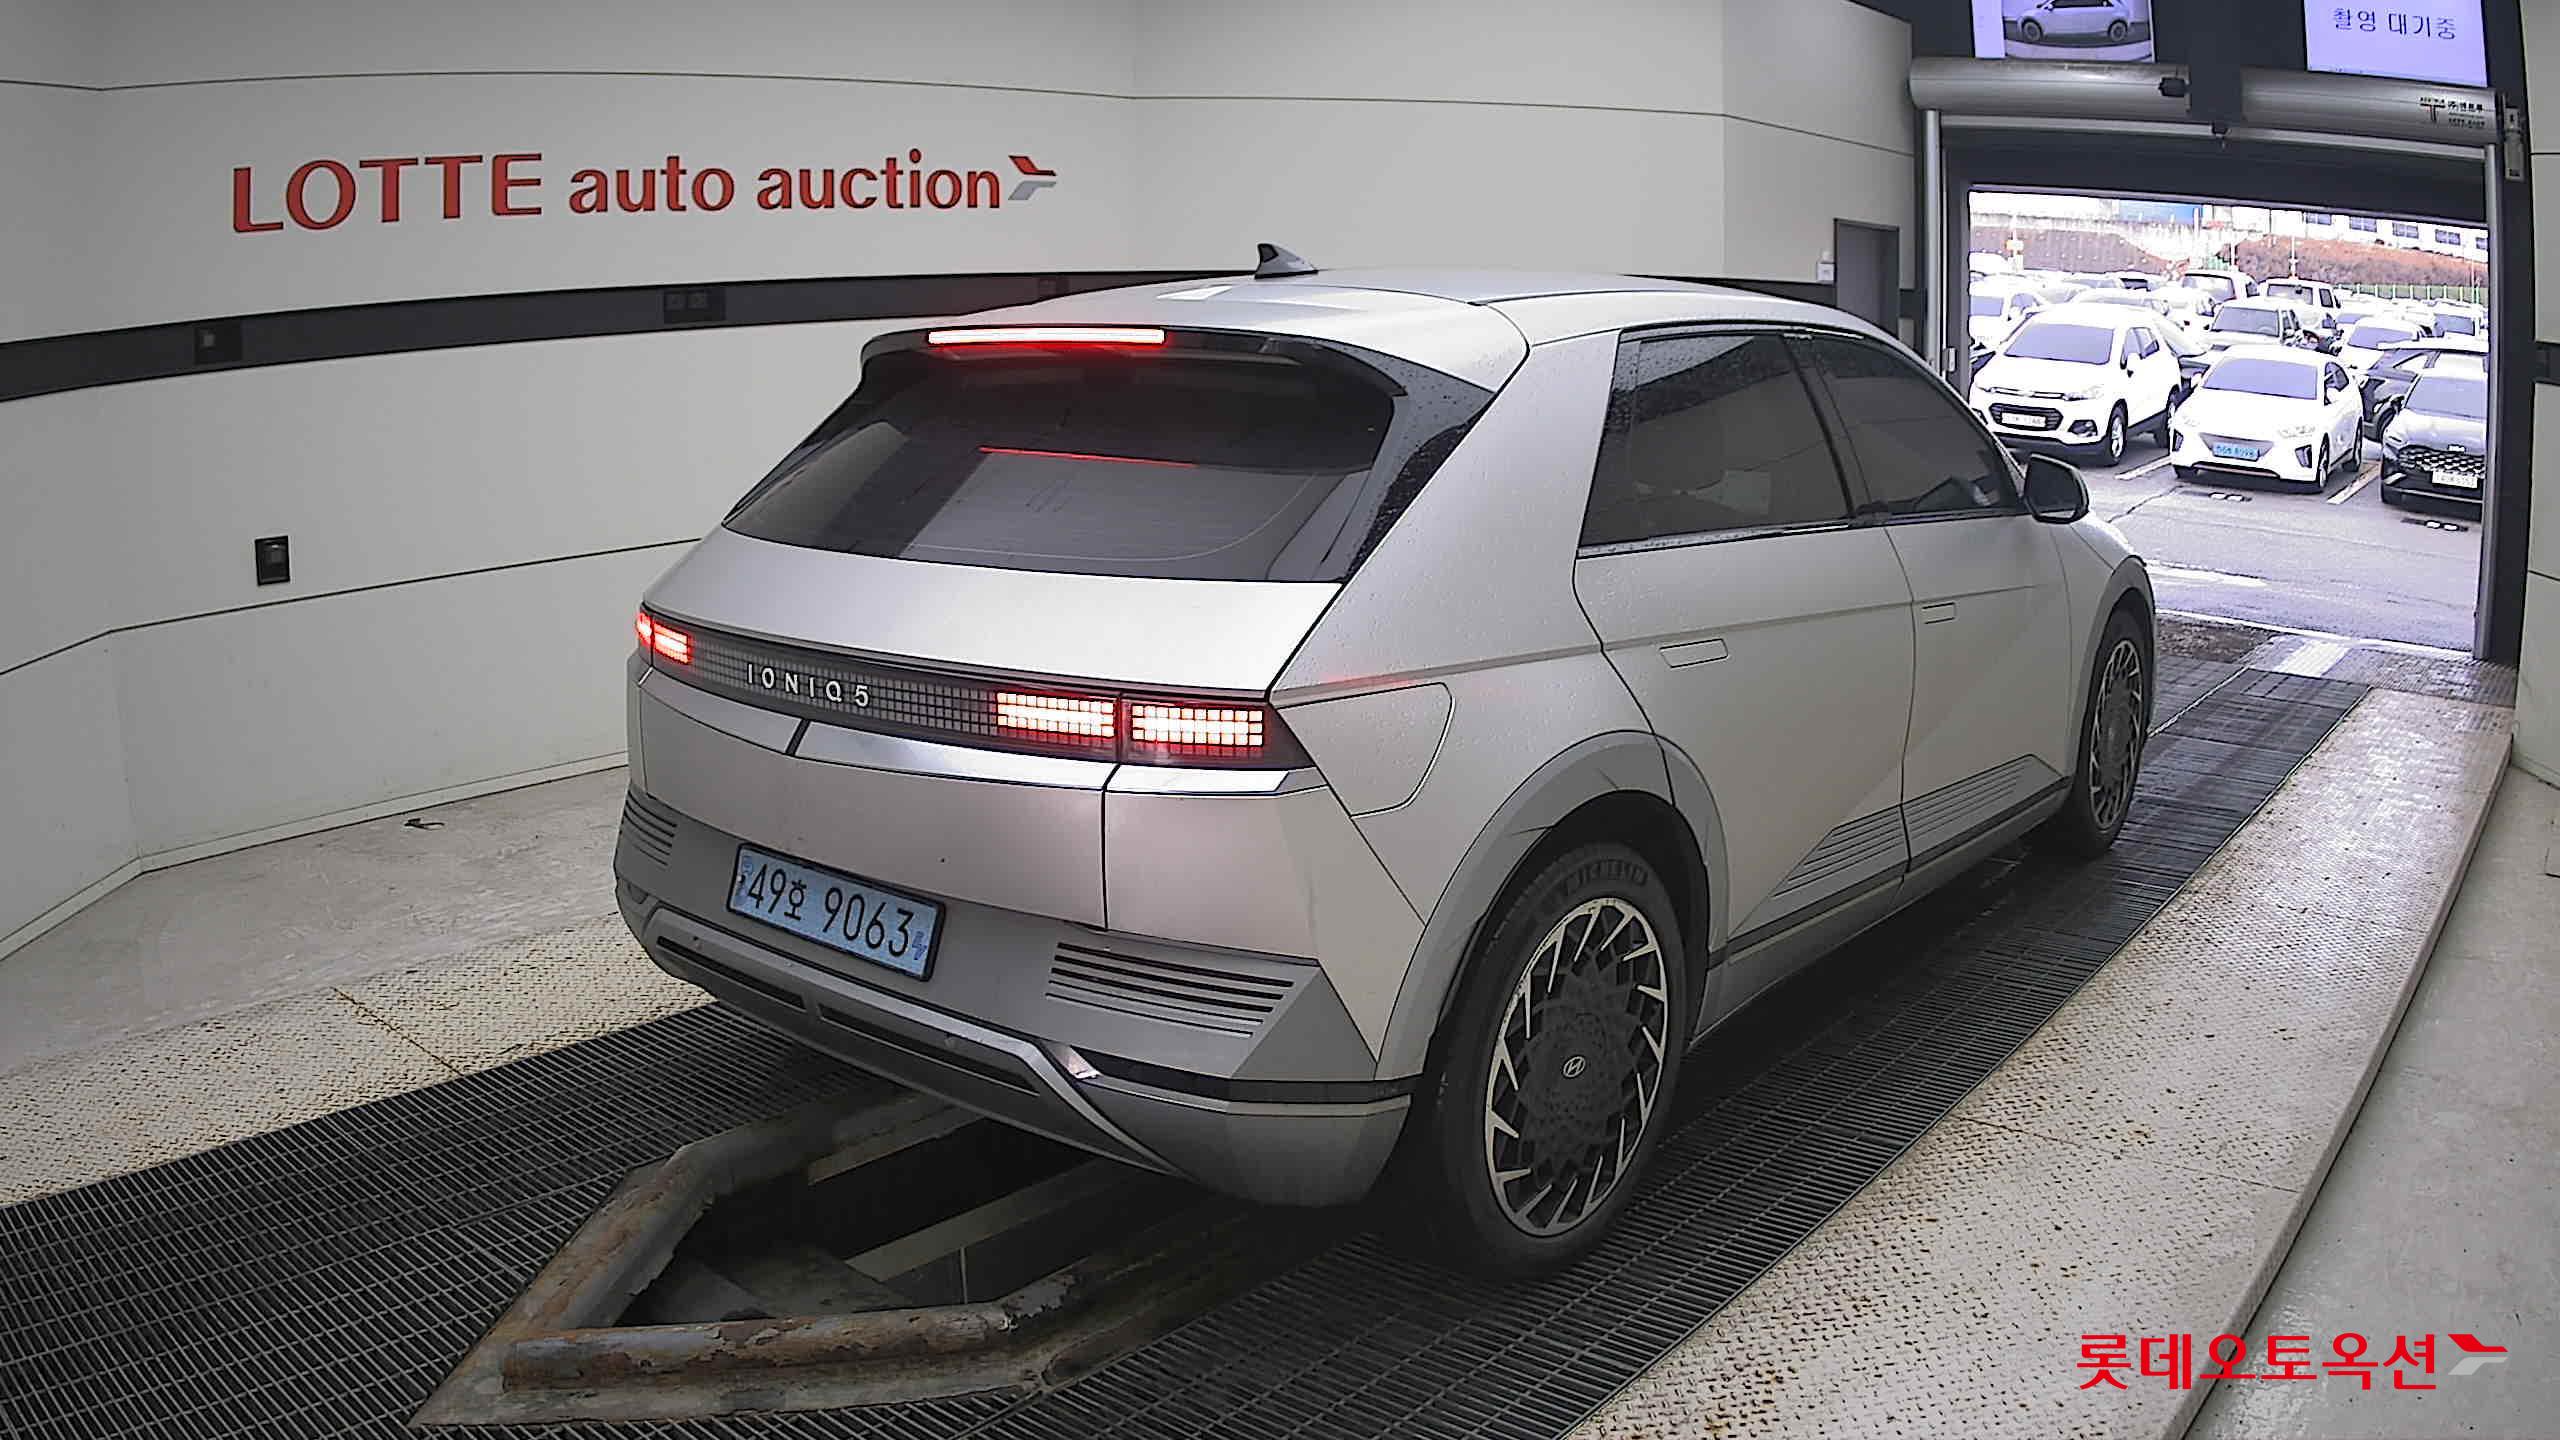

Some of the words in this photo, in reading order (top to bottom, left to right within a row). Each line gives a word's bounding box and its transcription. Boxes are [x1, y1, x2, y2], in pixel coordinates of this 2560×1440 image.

[2333, 8, 2376, 33] 촬영
[2388, 12, 2457, 40] 대기중
[232, 152, 543, 233] LOTTE
[568, 154, 736, 213] auto
[756, 147, 1001, 211] auction
[747, 663, 842, 702] IONIQ
[855, 684, 869, 708] 5
[748, 863, 807, 921] 49호
[822, 886, 915, 958] 9063
